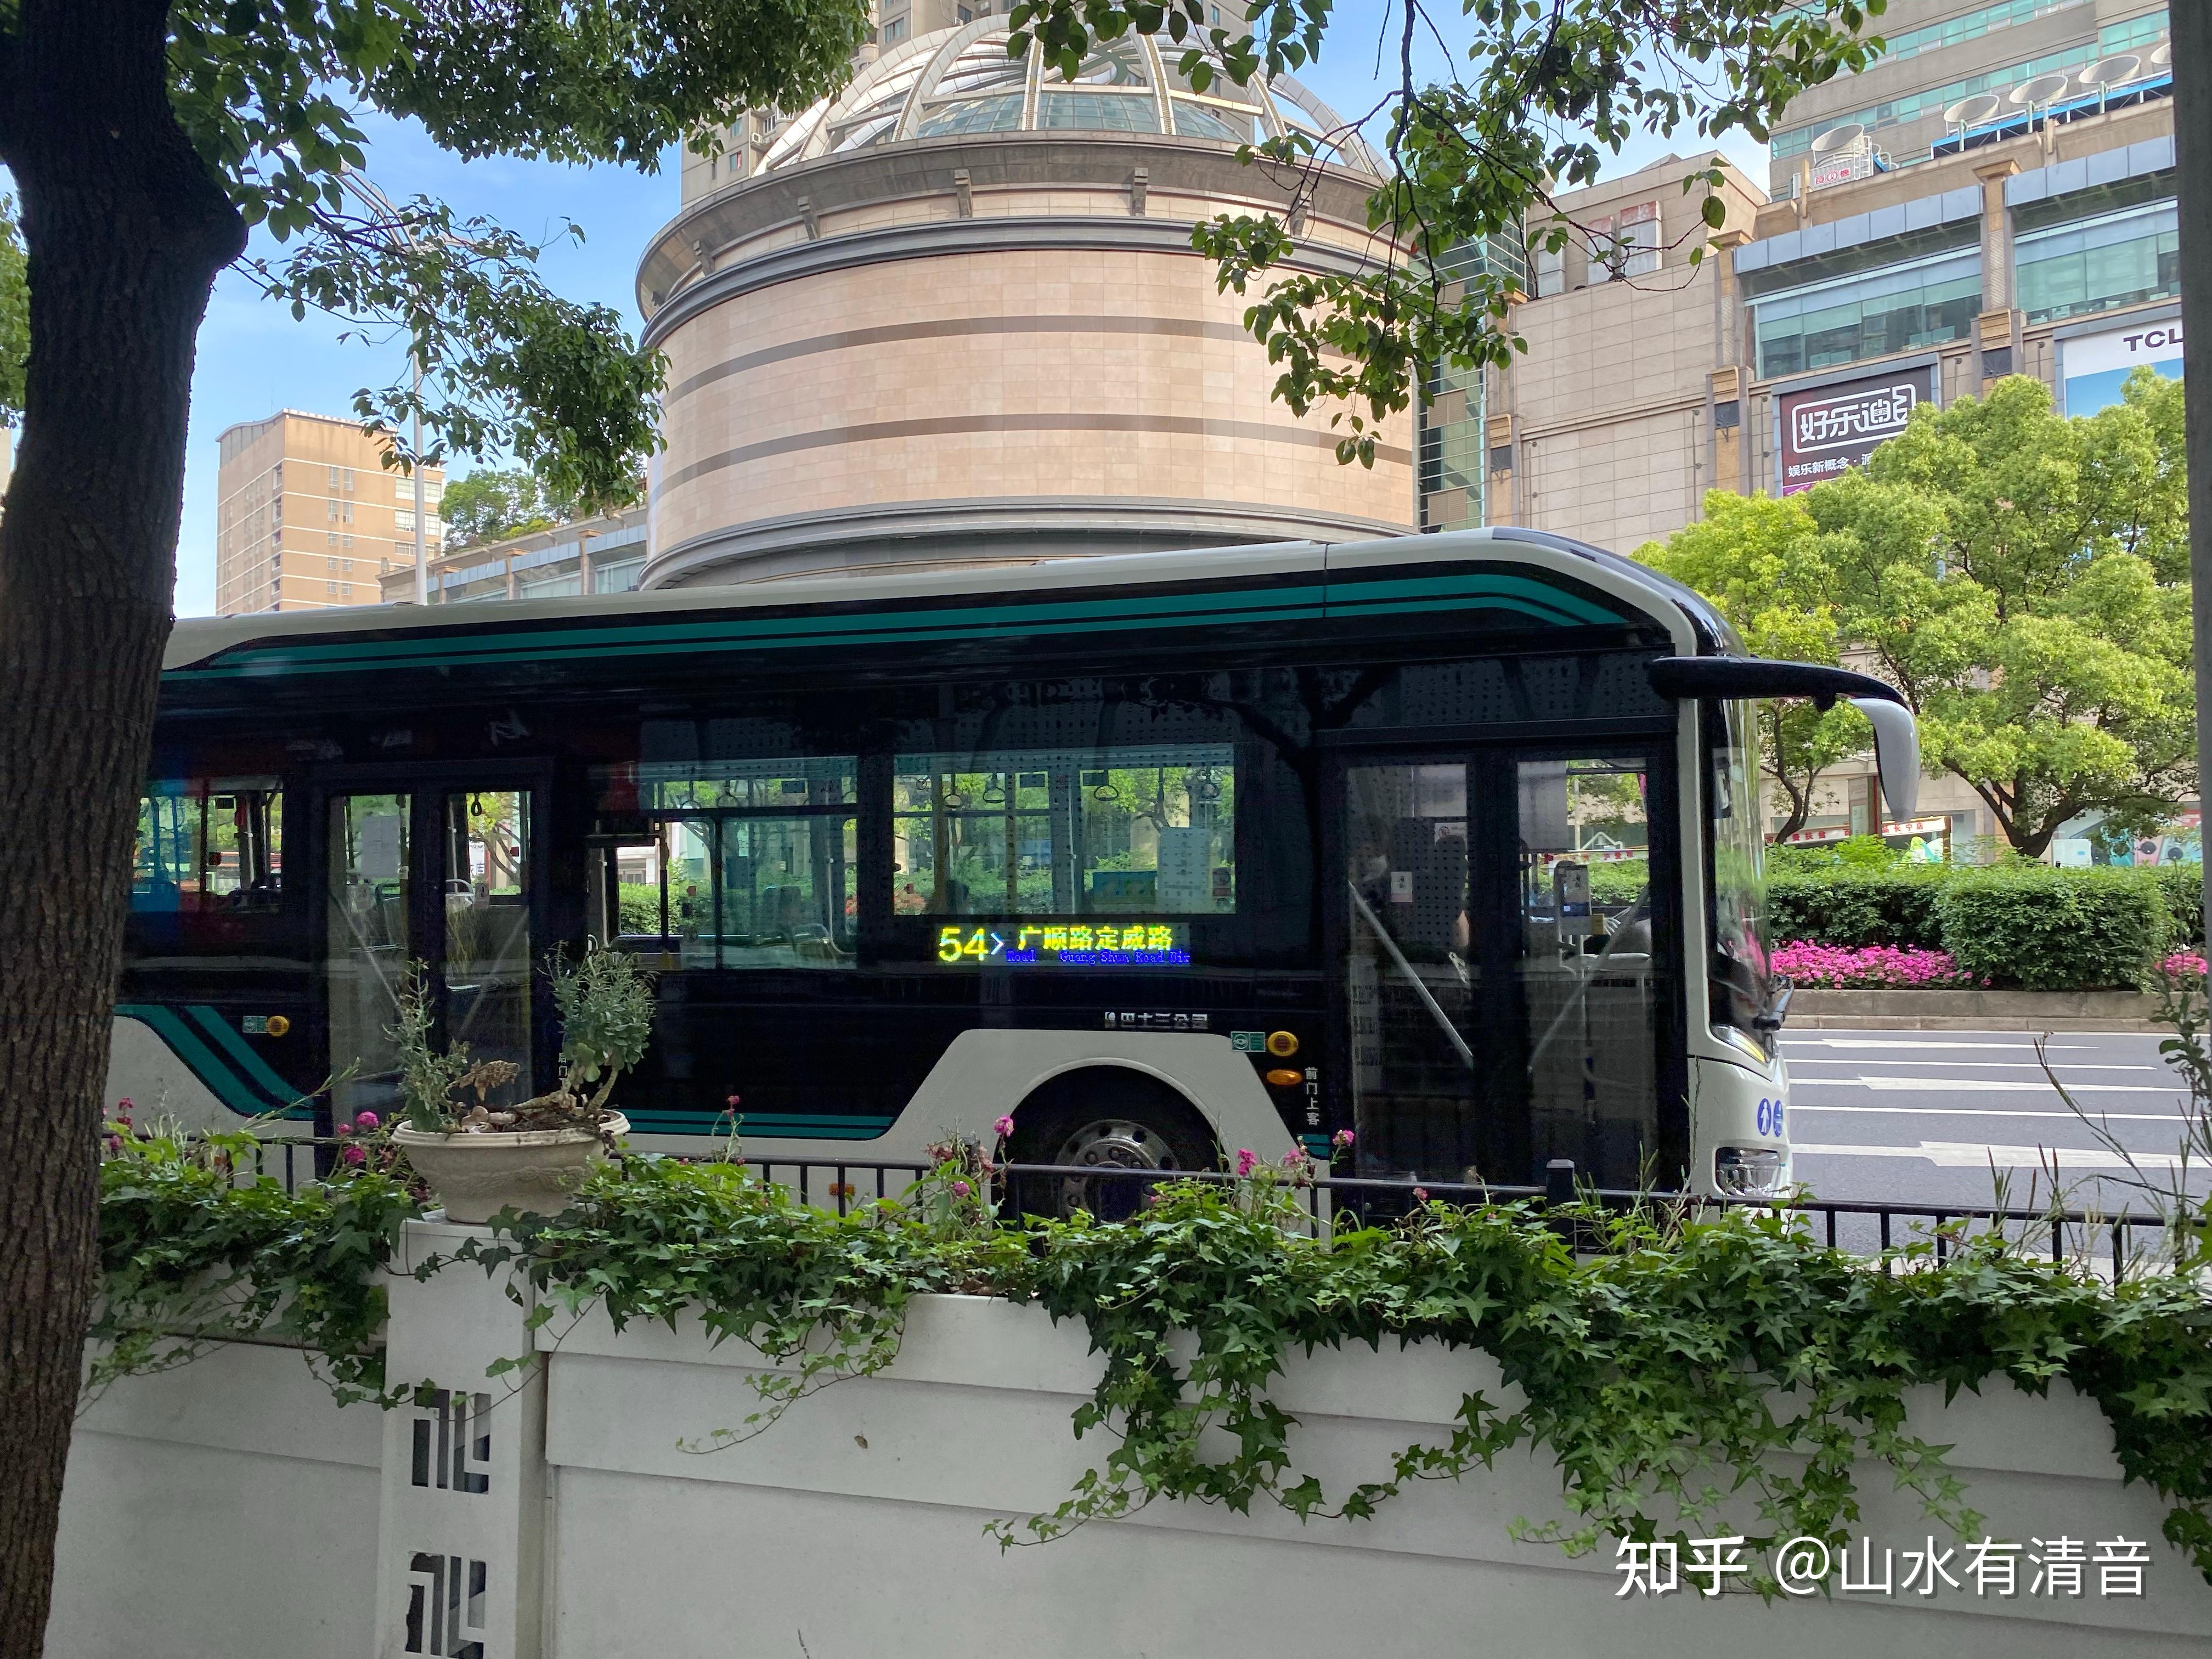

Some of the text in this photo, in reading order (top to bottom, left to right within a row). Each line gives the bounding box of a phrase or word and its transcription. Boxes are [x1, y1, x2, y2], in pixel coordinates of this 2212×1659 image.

[2123, 328, 2183, 352] TCL
[939, 927, 988, 962] 54
[1018, 926, 1172, 951] 广顺路定威路
[1007, 950, 1036, 962] Road
[1059, 950, 1096, 965] Guang
[1100, 949, 1130, 963] Shun
[1135, 950, 1165, 963] Road
[1305, 1067, 1319, 1125] 前门上客
